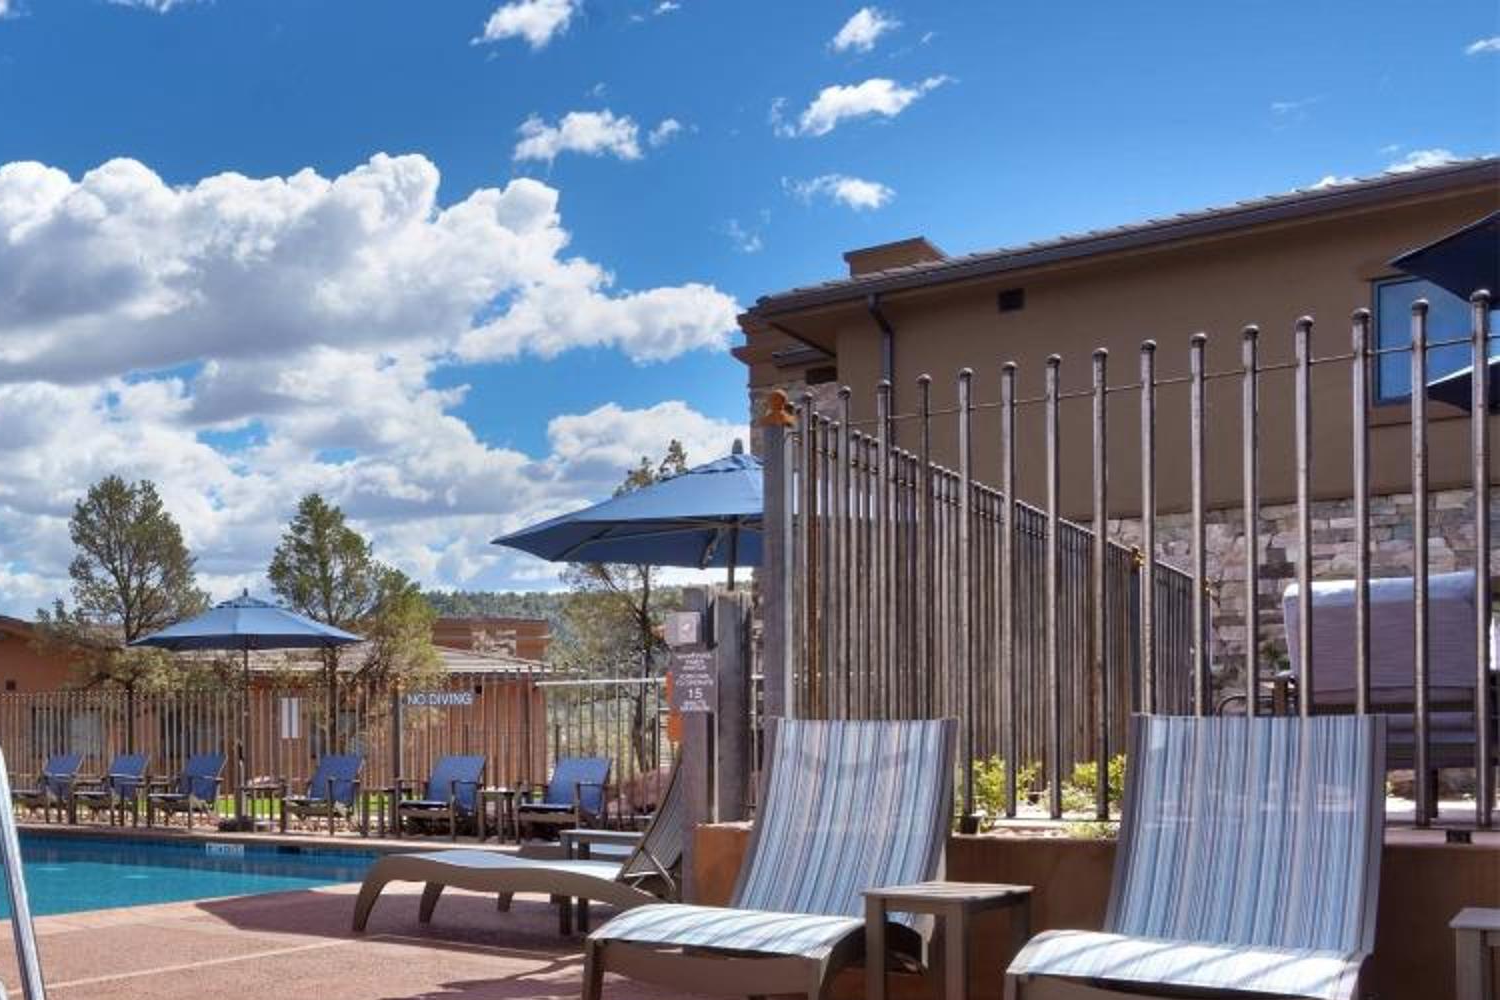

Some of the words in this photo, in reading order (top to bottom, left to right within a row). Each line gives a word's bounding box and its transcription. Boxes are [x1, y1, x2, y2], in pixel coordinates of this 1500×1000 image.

[407, 693, 425, 705] NO
[429, 692, 472, 705] DIVING
[688, 687, 703, 699] 15
